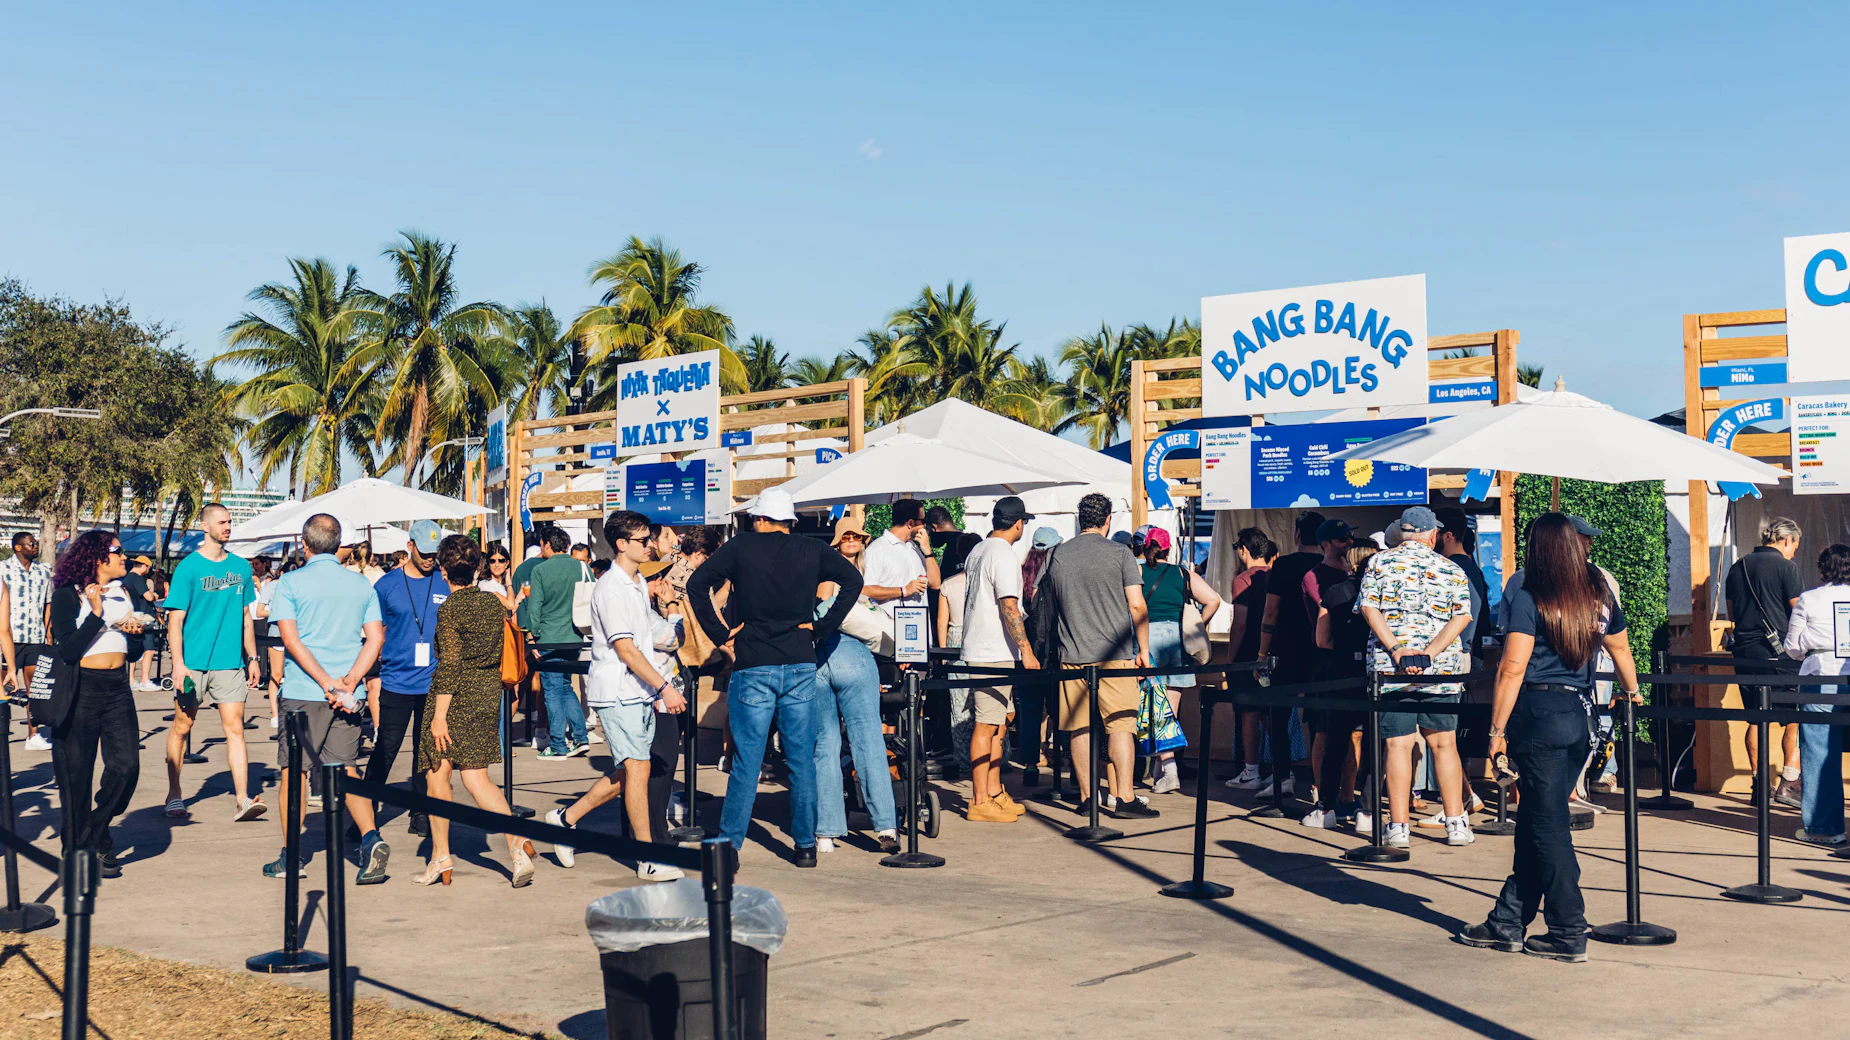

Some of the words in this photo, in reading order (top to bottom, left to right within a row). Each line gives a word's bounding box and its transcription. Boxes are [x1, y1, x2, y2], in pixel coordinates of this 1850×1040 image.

[1211, 303, 1305, 382] BANG
[1314, 299, 1413, 369] BANG
[621, 370, 649, 400] NIXTA
[652, 361, 711, 396] TAQUERIA
[1244, 355, 1379, 401] NOODLES
[1436, 388, 1449, 398] Los
[1450, 386, 1481, 399] Angeles,
[1481, 385, 1492, 395] CA
[1731, 373, 1754, 382] MiMo
[1797, 402, 1823, 410] Caracas
[1824, 401, 1848, 410] Bakery
[621, 416, 709, 448] MATY'S
[1713, 419, 1737, 449] DER
[1735, 402, 1773, 424] HERE
[821, 450, 837, 462] PICK
[1147, 442, 1166, 482] ORDER
[1165, 433, 1190, 448] HERE
[1360, 464, 1369, 473] OUT
[521, 482, 529, 512] ORDER
